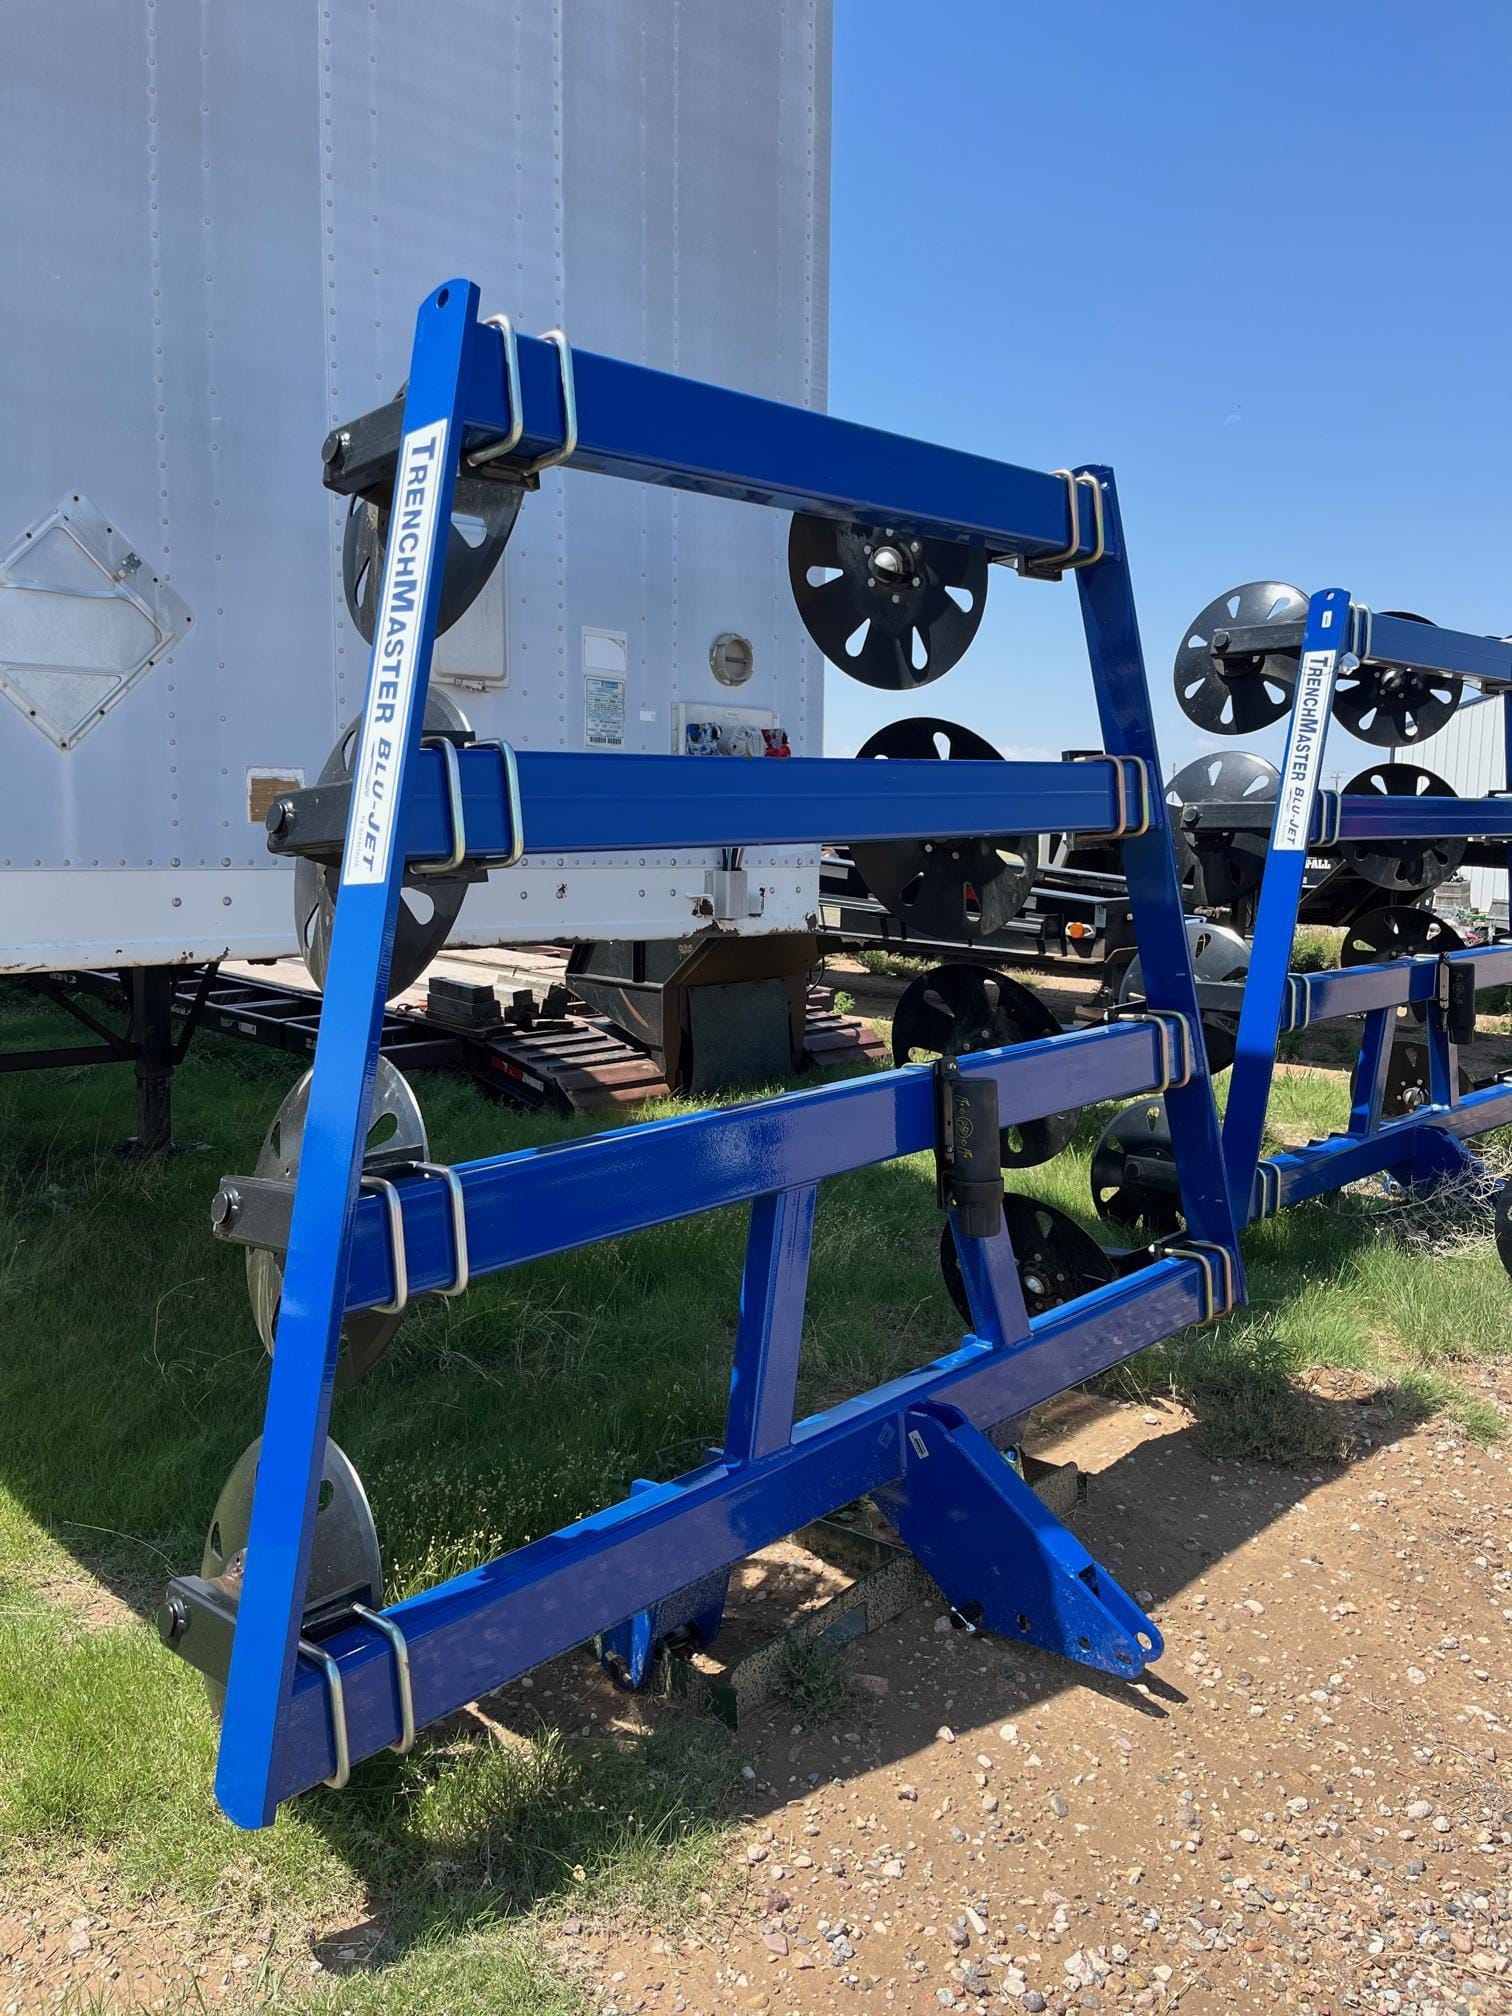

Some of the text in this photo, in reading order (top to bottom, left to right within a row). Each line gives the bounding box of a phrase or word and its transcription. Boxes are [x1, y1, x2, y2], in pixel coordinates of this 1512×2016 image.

[362, 436, 437, 872] TRENCHMASTER BLU-JET
[1286, 656, 1329, 845] TRENCHMASTER BLU-JET
